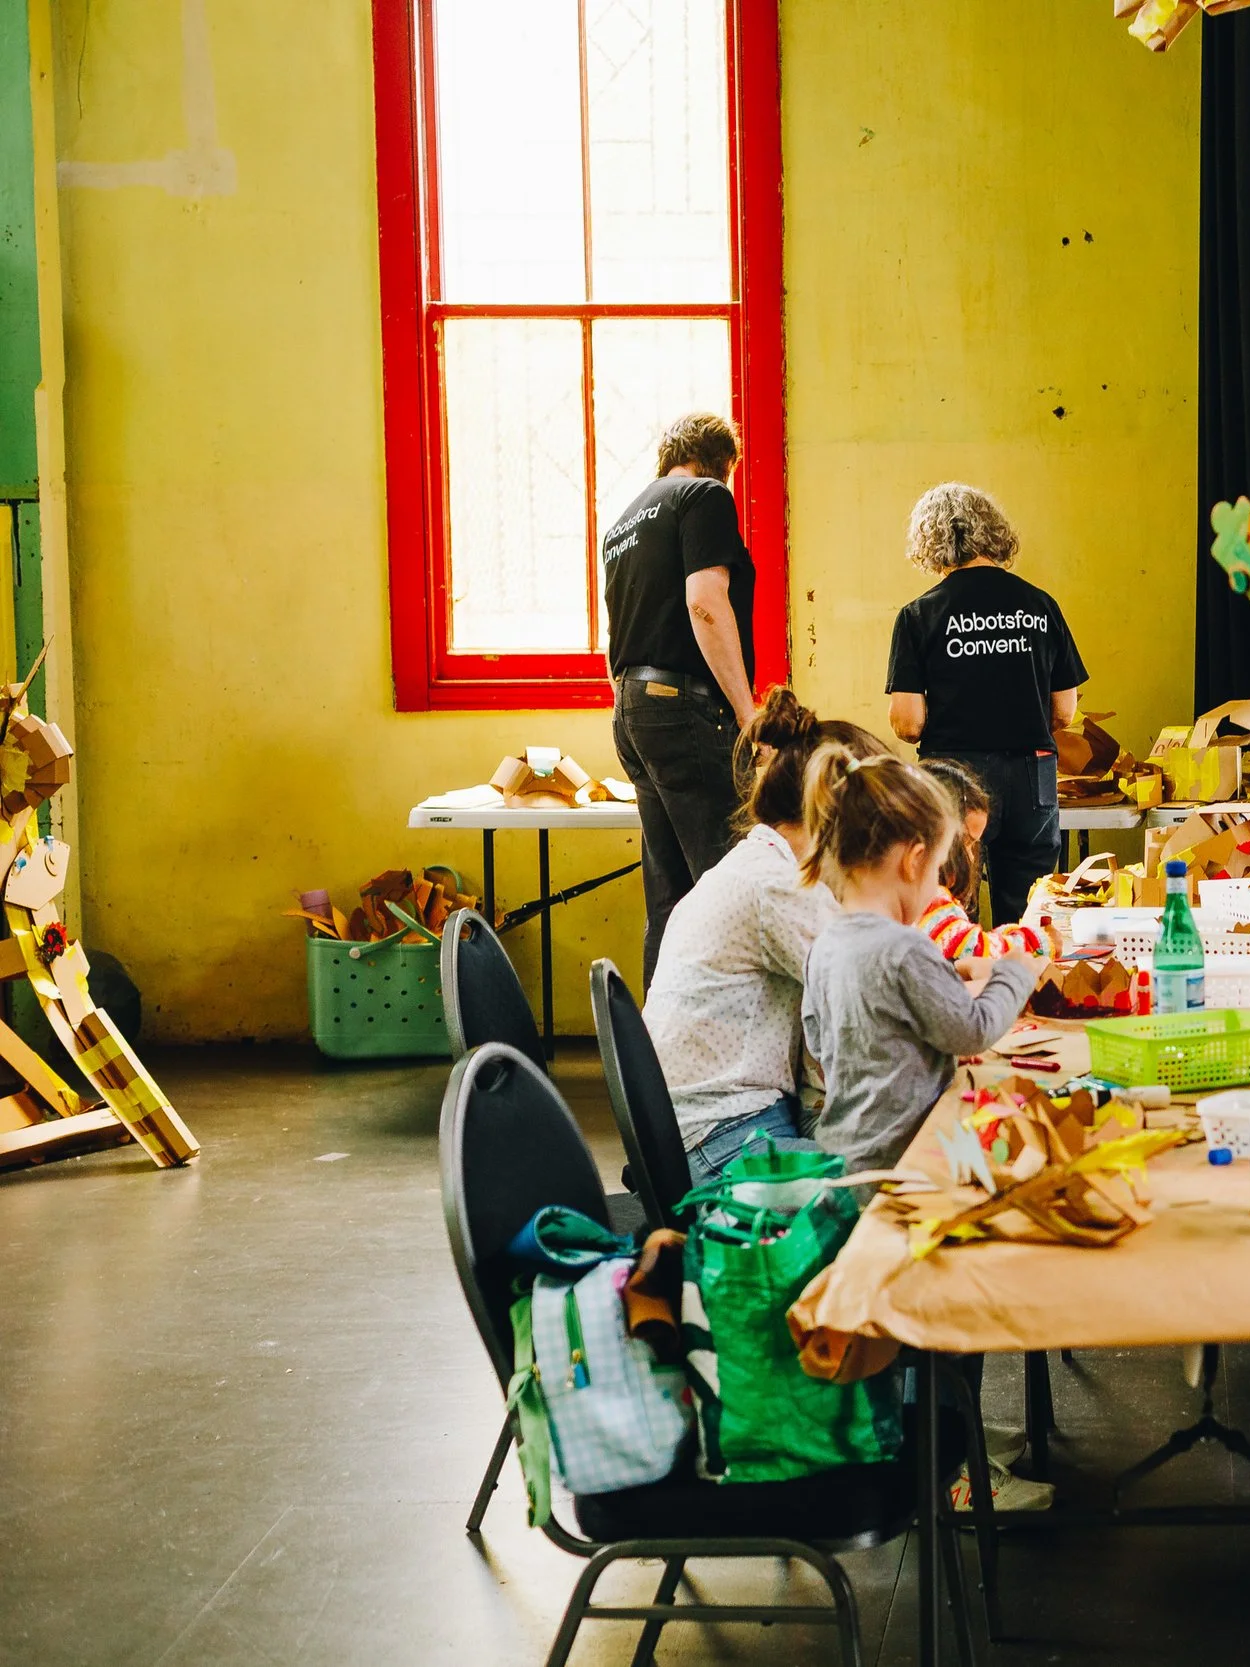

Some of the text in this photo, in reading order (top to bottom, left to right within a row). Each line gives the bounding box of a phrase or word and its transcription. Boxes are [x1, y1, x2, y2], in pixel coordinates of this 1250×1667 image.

[605, 502, 661, 542] bbotsford
[604, 532, 639, 563] onvent.
[946, 609, 1047, 635] Abbotsford
[947, 635, 1032, 658] Convent.
